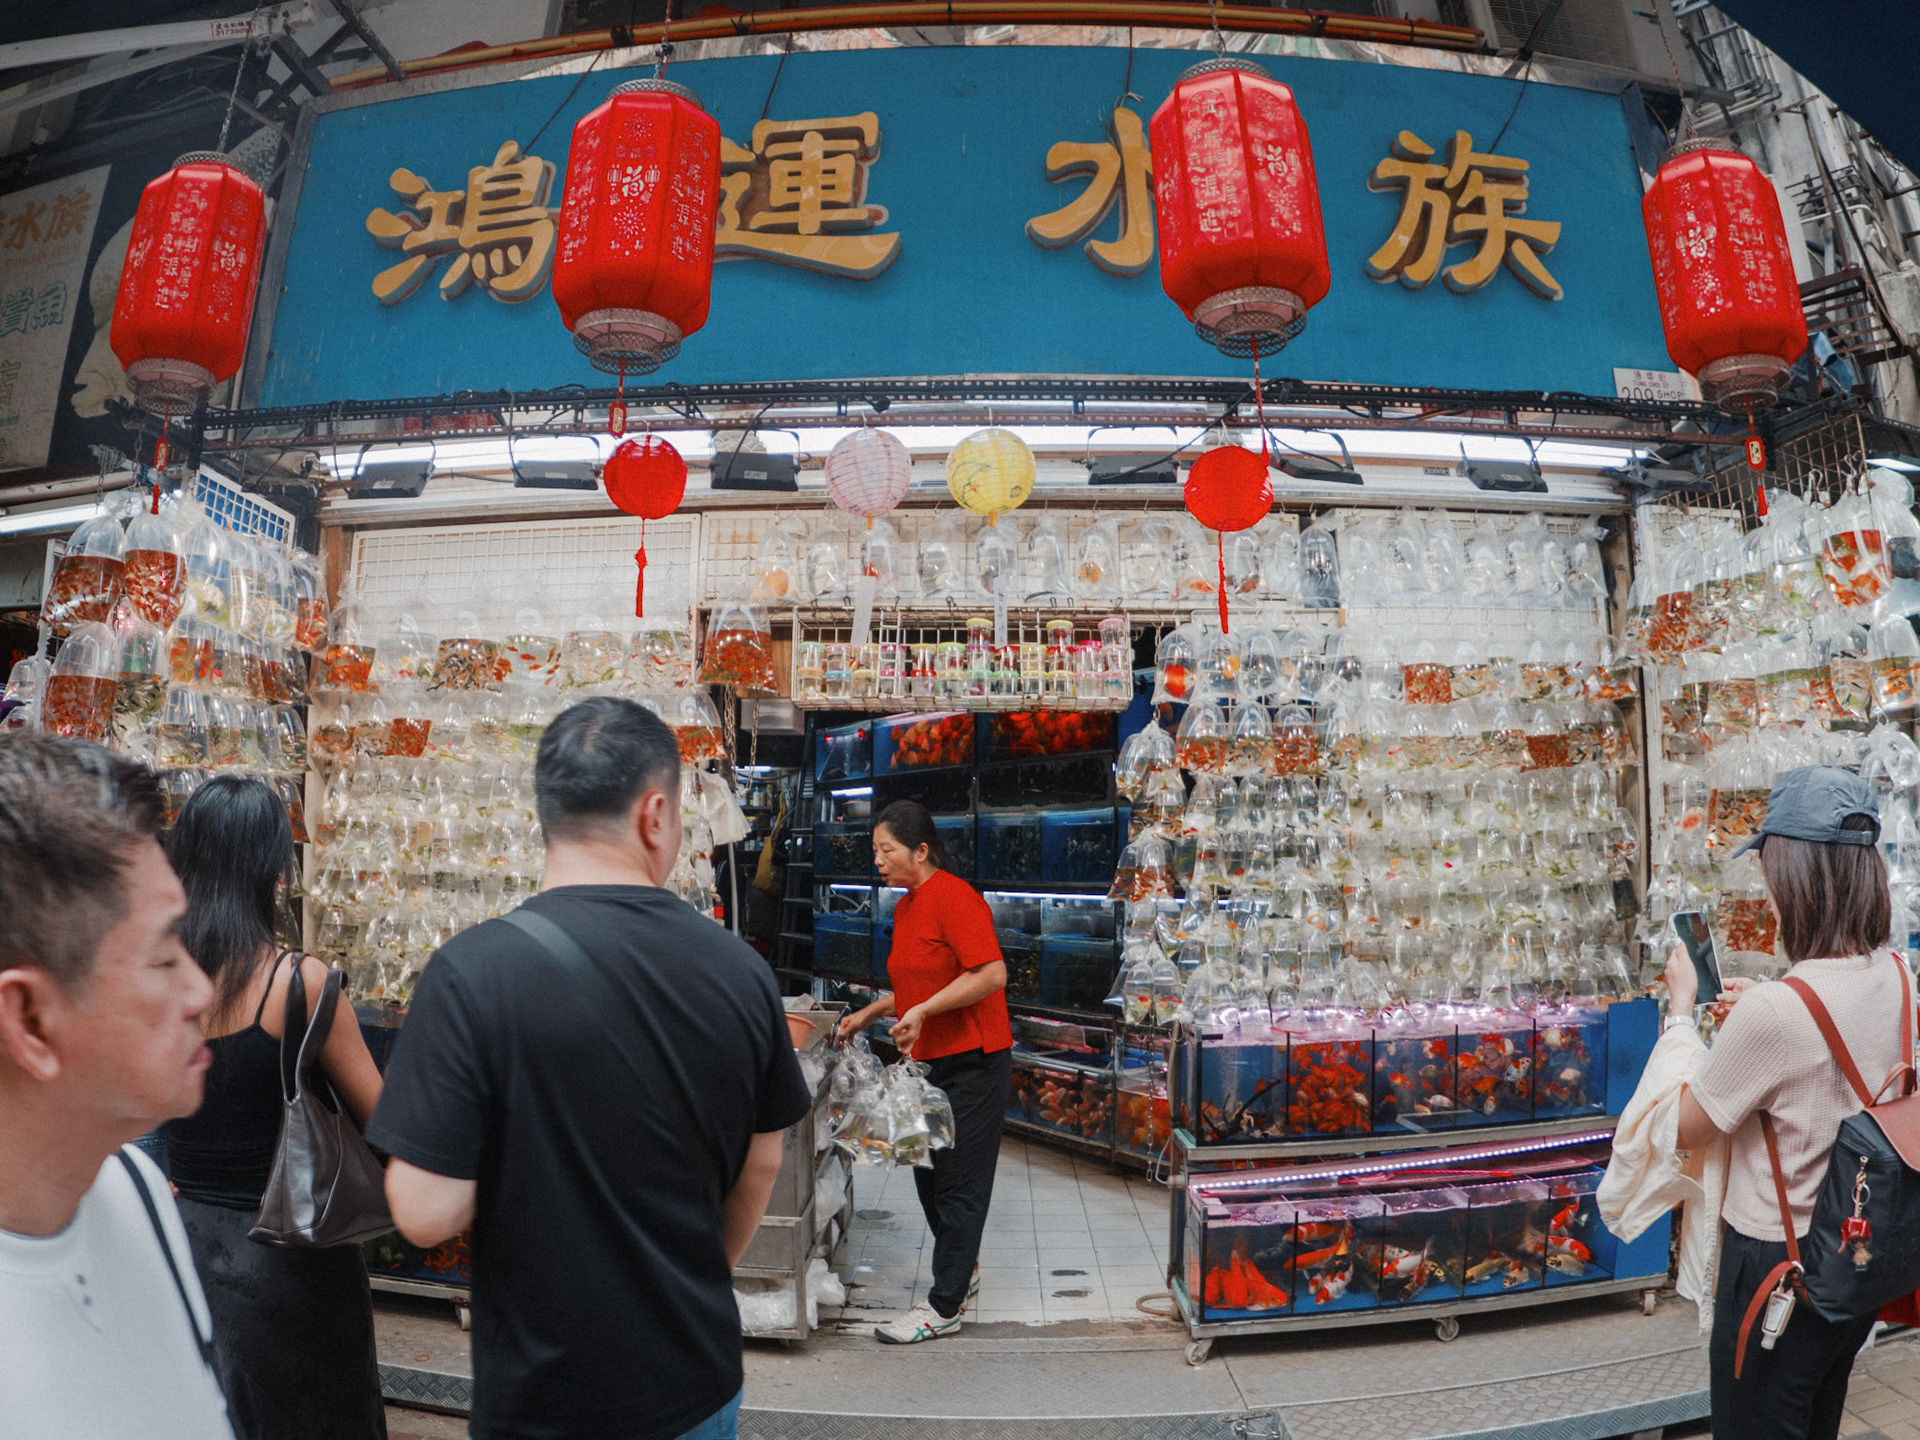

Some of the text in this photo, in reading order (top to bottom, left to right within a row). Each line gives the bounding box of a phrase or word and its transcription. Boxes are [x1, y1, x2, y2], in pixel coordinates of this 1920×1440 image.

[367, 107, 1562, 304] 鴻運水族
[621, 165, 644, 197] 福
[0, 187, 93, 250] 水族
